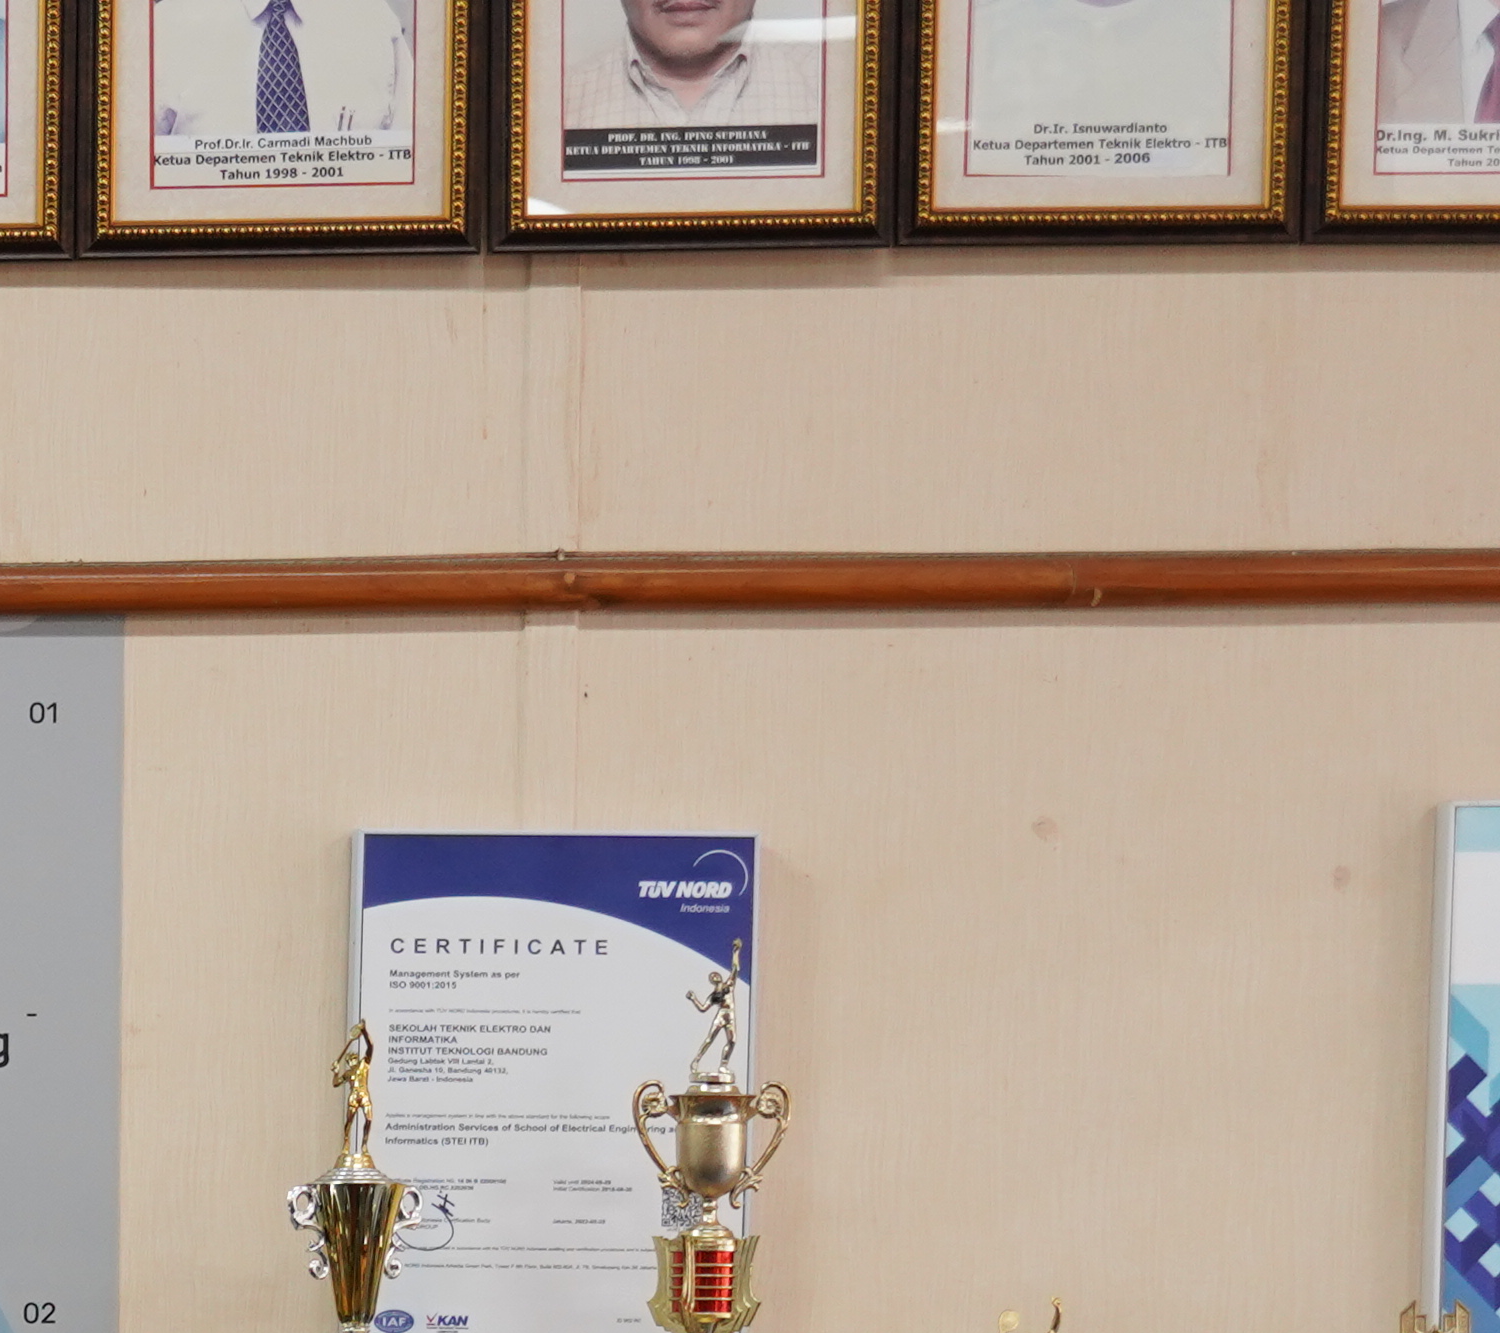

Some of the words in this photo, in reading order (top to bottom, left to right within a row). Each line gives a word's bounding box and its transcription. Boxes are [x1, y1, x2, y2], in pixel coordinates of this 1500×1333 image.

[1033, 123, 1068, 135] Dr.Ir.
[1072, 122, 1168, 134] Isnuwardianto
[194, 138, 254, 150] Prof.Dr.Ir.
[257, 136, 311, 149] Carmadi
[314, 134, 373, 147] Machbub
[29, 701, 57, 724] 01
[674, 881, 732, 899] NORD
[679, 902, 730, 914] Indonesia
[390, 937, 608, 956] CERTIFICATE
[389, 969, 451, 982] Management
[452, 969, 489, 983] System
[490, 971, 502, 980] as
[504, 971, 521, 983] per
[389, 980, 407, 990] ISO
[408, 980, 457, 990] 9001:2015
[388, 1023, 438, 1033] SEKOLAH
[439, 1024, 477, 1033] TEKNIK
[479, 1024, 527, 1034] ELEKTRO
[529, 1025, 552, 1034] DAN
[388, 1035, 458, 1044] INFORMATIKA
[387, 1046, 433, 1056] INSTITUT
[435, 1046, 495, 1056] TEKNOLOGI
[496, 1047, 548, 1056] BANDUNG
[385, 1122, 456, 1132] Administration
[458, 1122, 499, 1132] Services
[501, 1122, 512, 1133] of
[513, 1123, 548, 1133] School
[549, 1123, 560, 1133] of
[561, 1123, 607, 1133] Electrical
[608, 1124, 667, 1137] Enginring
[384, 1136, 439, 1146] Informatics
[440, 1136, 467, 1147] (STEI
[468, 1136, 489, 1147] ITB)
[23, 1301, 56, 1325] 02
[379, 1315, 407, 1328] IAF
[436, 1315, 469, 1328] KAN
